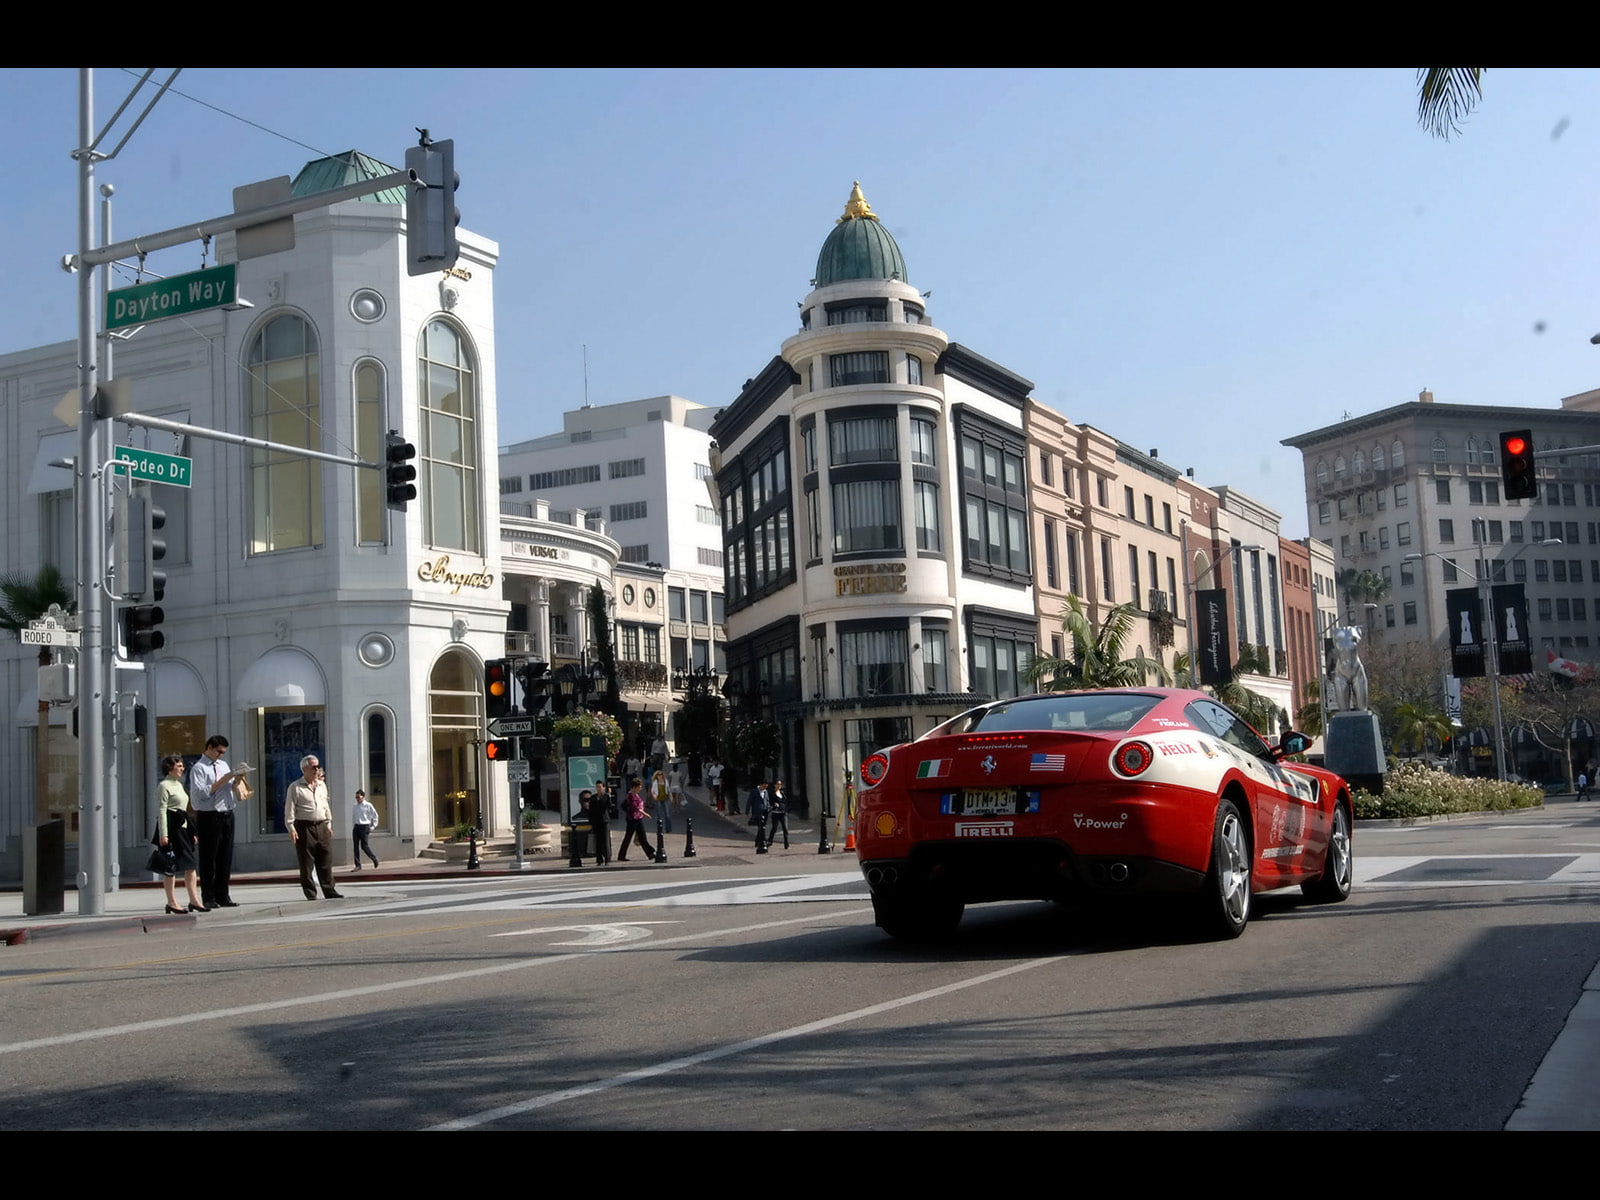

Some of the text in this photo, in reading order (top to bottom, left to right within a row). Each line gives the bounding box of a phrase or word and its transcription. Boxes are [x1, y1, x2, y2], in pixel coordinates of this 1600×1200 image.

[114, 280, 226, 320] Dayton Way
[170, 462, 185, 479] Dr
[529, 545, 559, 560] VERSACE
[24, 631, 52, 644] RODEO
[500, 724, 514, 732] ONE
[1158, 744, 1198, 756] HELIX
[955, 821, 1014, 837] PIRELLI
[1073, 818, 1126, 829] V-Power
